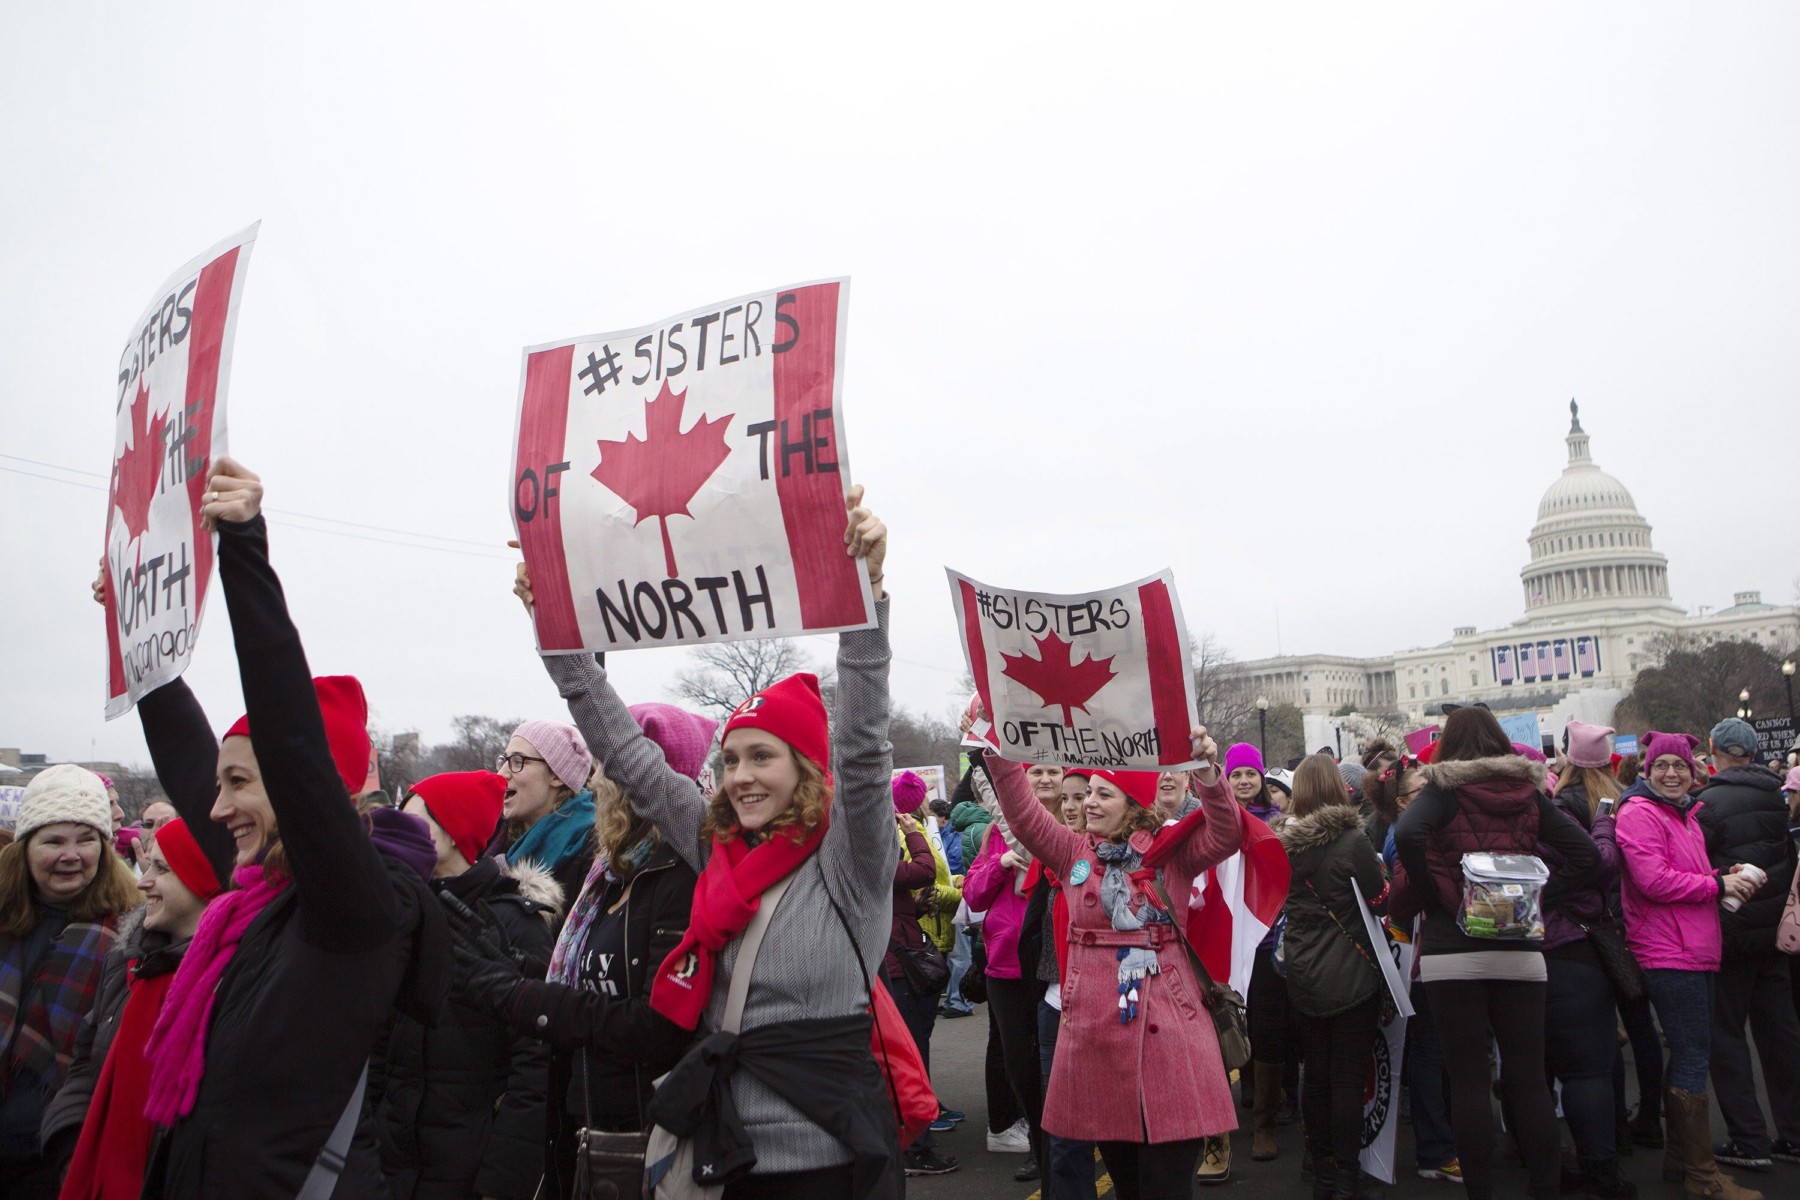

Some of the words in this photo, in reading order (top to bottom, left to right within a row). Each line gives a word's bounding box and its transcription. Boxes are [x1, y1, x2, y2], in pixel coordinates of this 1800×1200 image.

[159, 399, 204, 495] THE
[515, 461, 571, 523] OF
[747, 408, 838, 481] THE
[113, 542, 191, 638] NORTH
[596, 564, 776, 644] NORTH
[976, 589, 1130, 637] #SISTERS
[1003, 721, 1039, 746] OF
[1041, 722, 1099, 754] THE
[1101, 727, 1162, 758] NORTH
[1755, 718, 1791, 729] CANNOT
[1757, 731, 1770, 741] ED
[1771, 729, 1796, 740] WHEN
[1783, 739, 1793, 748] AR
